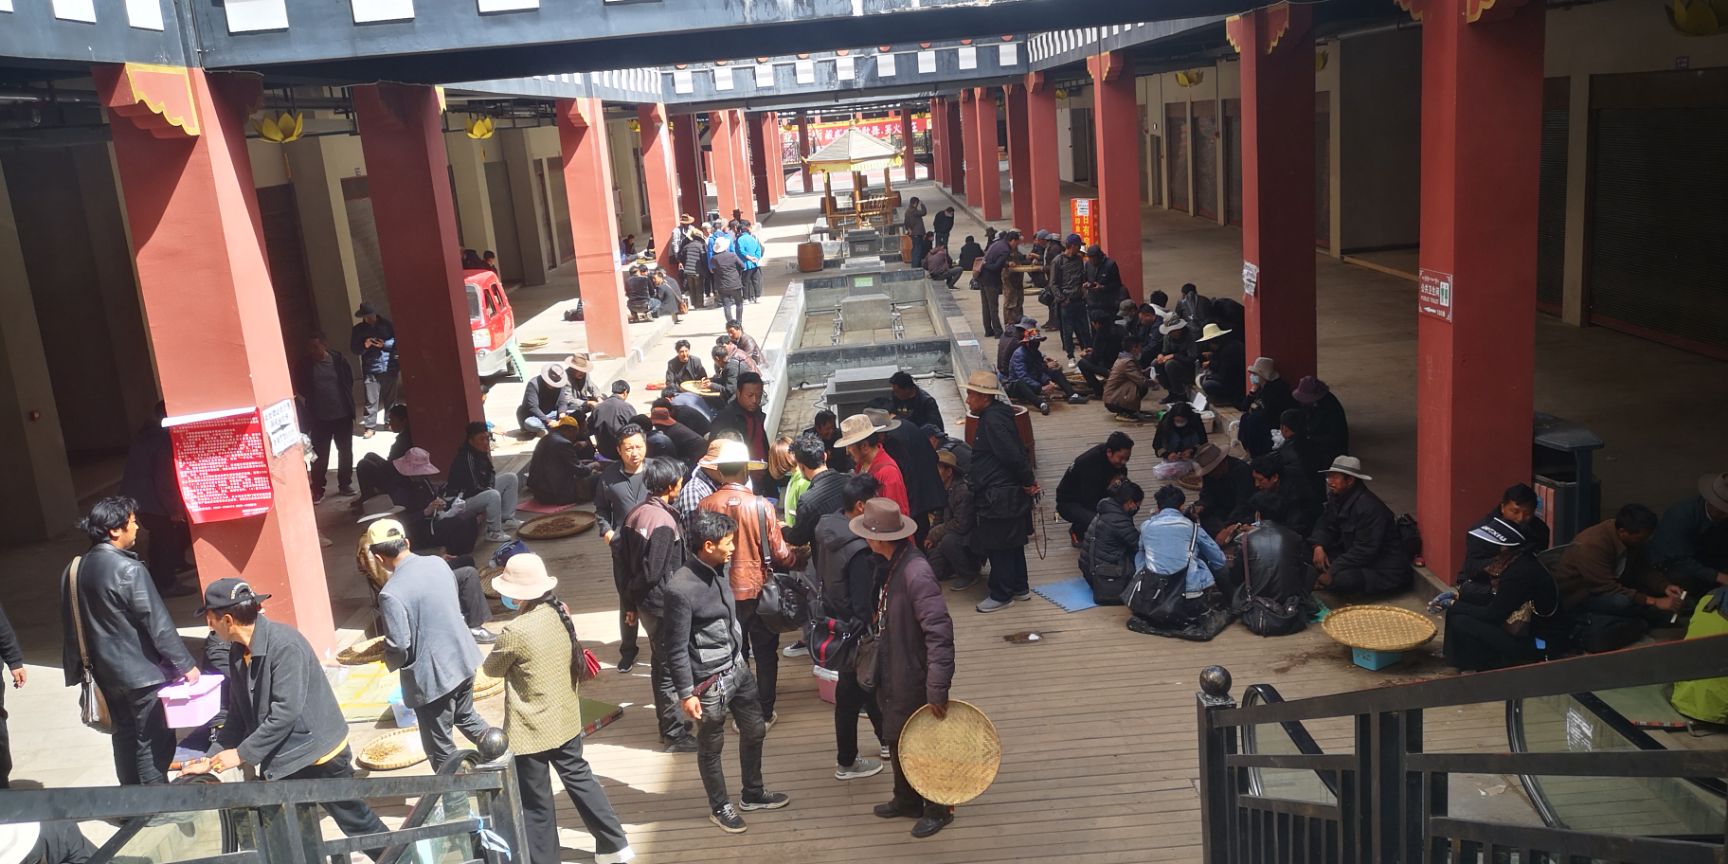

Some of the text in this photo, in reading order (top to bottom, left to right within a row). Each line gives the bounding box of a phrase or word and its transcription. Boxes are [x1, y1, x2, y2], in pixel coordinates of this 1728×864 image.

[1420, 284, 1440, 298] 公共卫生间
